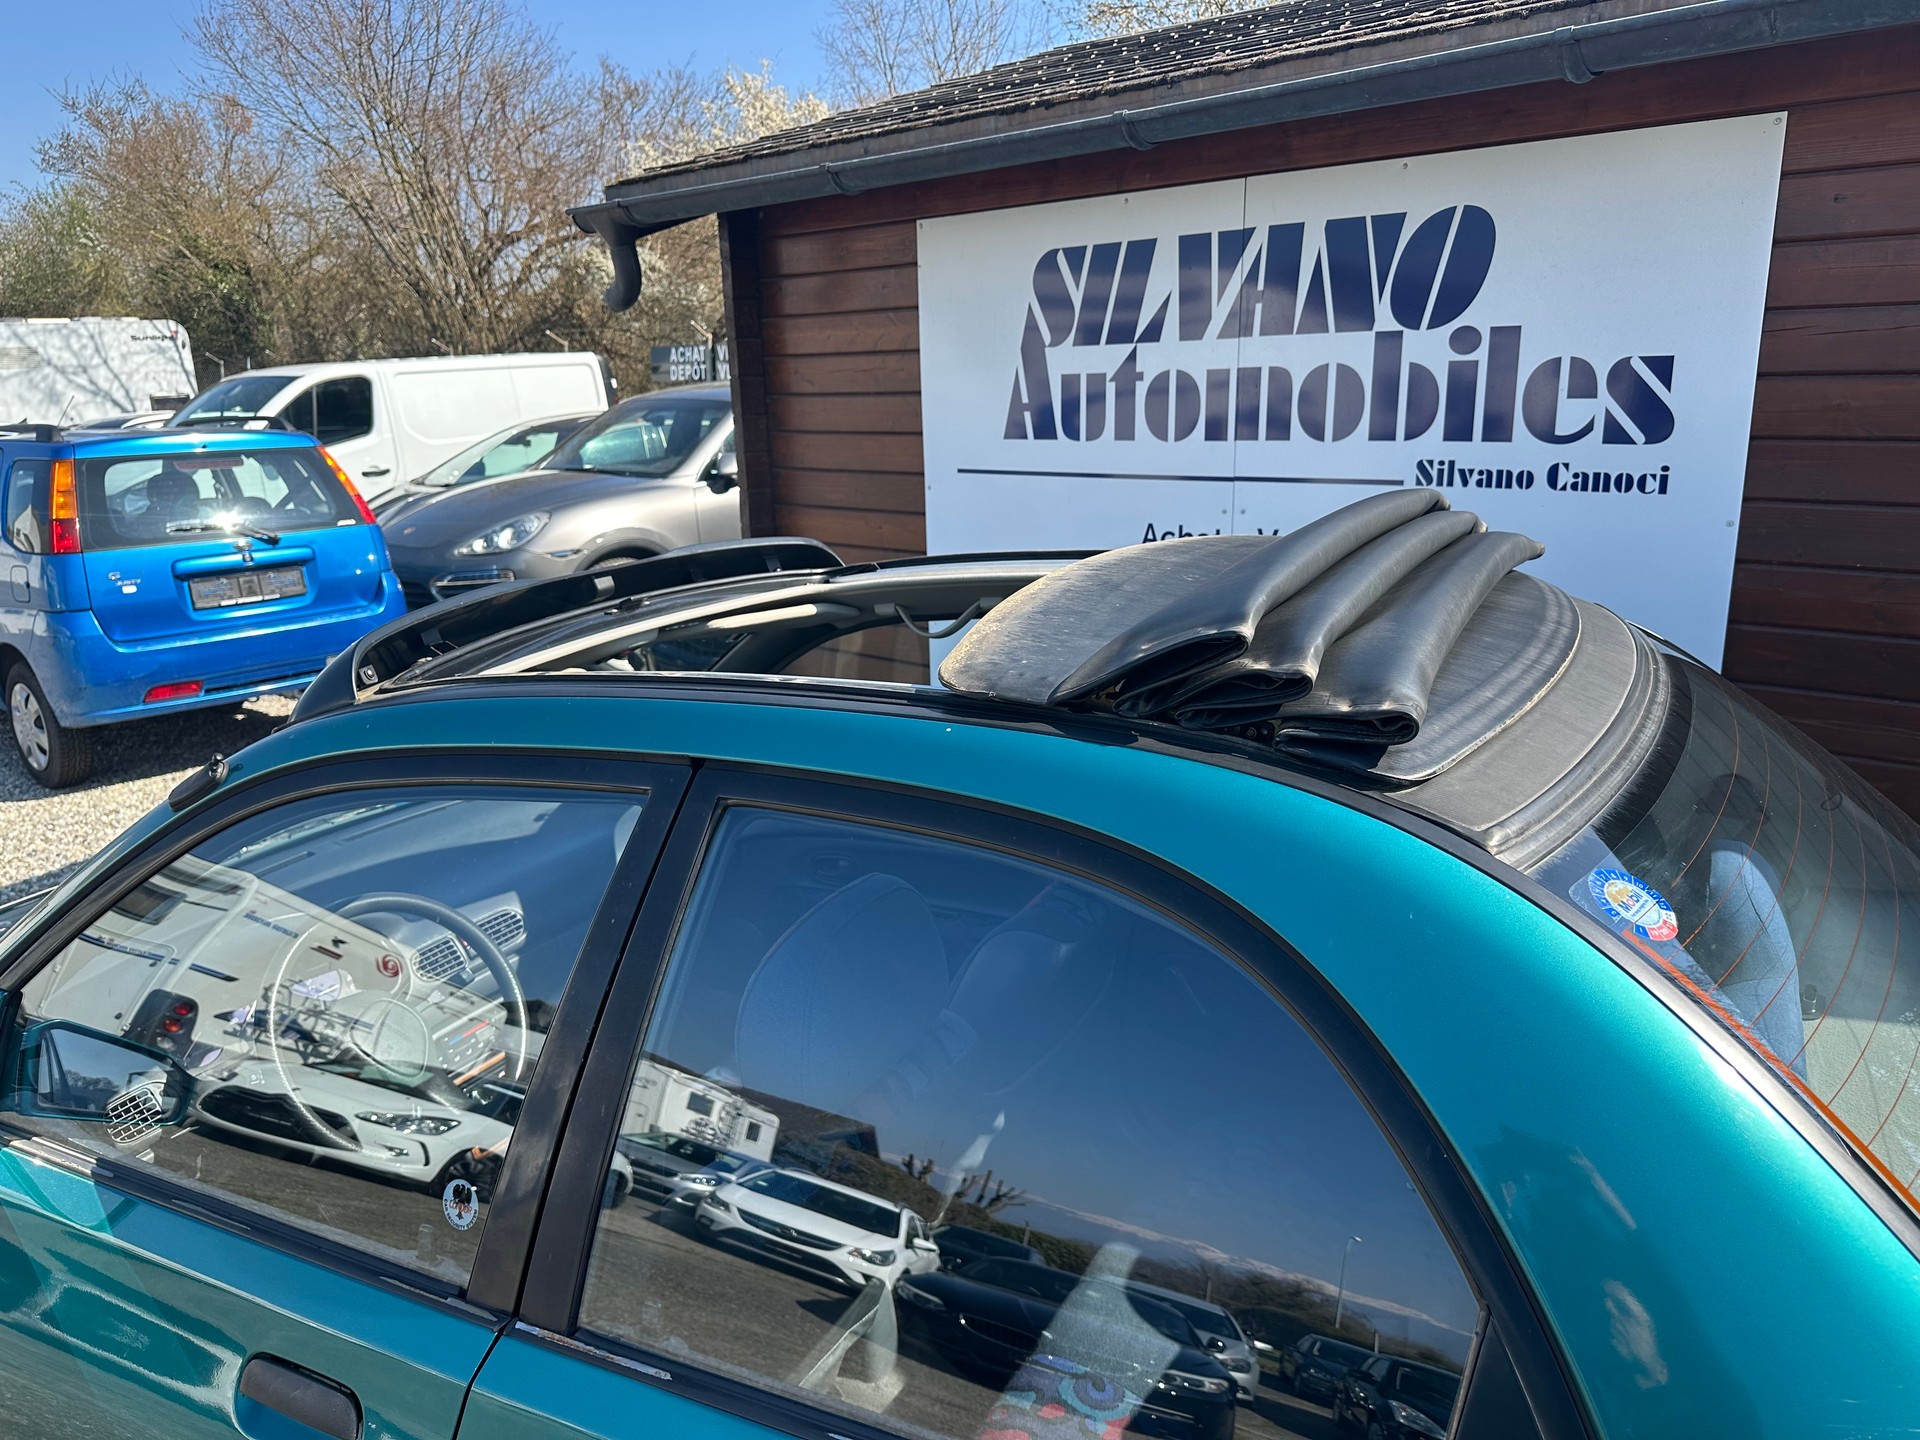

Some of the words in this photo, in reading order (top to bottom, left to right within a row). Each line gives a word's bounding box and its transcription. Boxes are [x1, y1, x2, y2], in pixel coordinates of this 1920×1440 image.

[1026, 205, 1497, 347] SILVANO
[670, 345, 706, 363] ACHAT
[1003, 322, 1675, 445] Automobiles
[1415, 459, 1535, 490] Silvano
[1546, 462, 1671, 495] Canoci
[1617, 888, 1644, 914] Mobil
